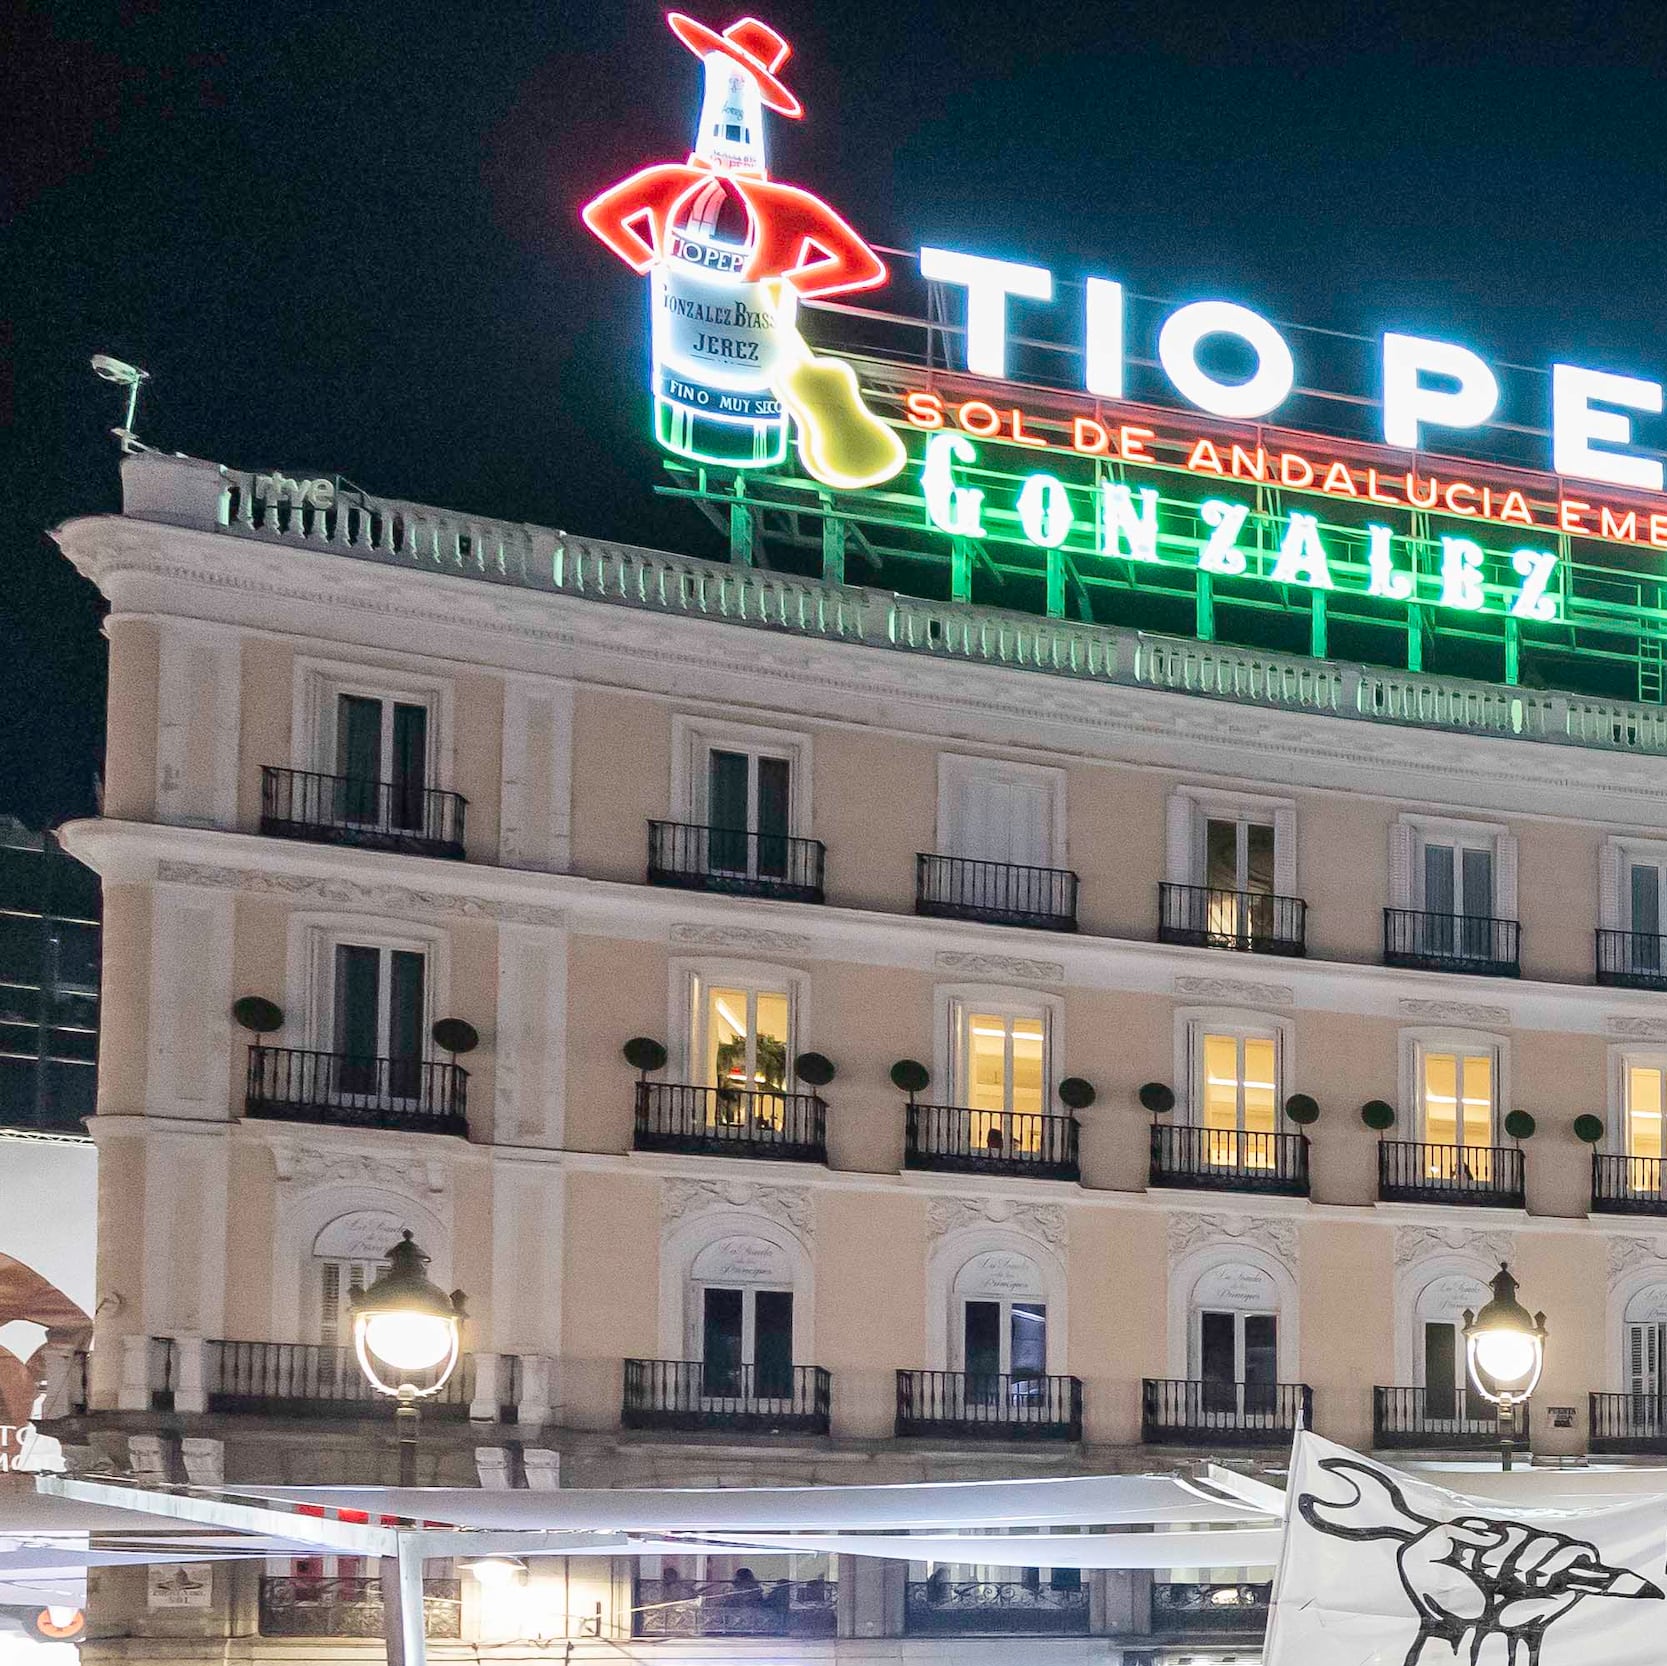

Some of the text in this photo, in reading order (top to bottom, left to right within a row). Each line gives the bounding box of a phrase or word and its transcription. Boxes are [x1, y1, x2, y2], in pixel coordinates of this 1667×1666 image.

[663, 284, 731, 326] ONZALEZ
[693, 333, 759, 361] JEREZ
[920, 246, 1294, 418] TIO
[669, 379, 783, 415] FINO MUY SECO
[906, 391, 1048, 448] SOL
[1073, 418, 1156, 463] DE
[1188, 439, 1534, 525] ANDALUCIA
[920, 434, 1558, 622] GONZALEZ
